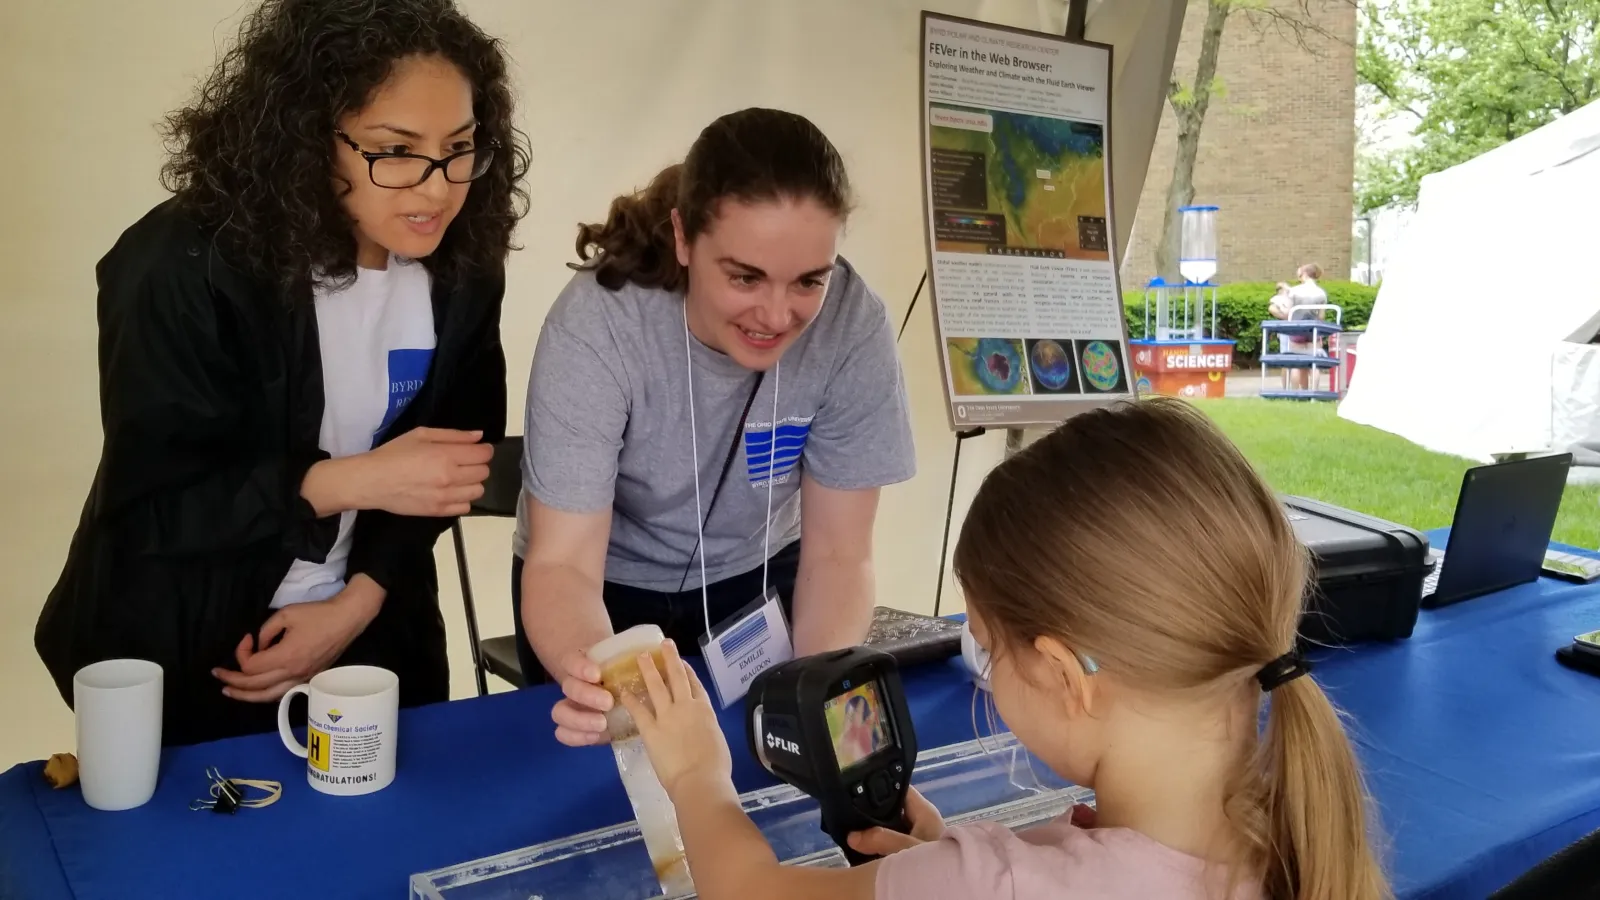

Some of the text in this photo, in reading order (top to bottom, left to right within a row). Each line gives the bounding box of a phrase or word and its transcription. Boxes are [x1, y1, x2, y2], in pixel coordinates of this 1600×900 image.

[929, 42, 1052, 72] FEVer in the Web Browser:
[928, 60, 957, 72] Exploring
[959, 64, 985, 75] Weather
[986, 69, 997, 77] and
[998, 71, 1020, 80] Climate
[1035, 76, 1045, 84] the
[1046, 78, 1060, 87] Fluid
[1061, 80, 1075, 89] Earth
[1076, 83, 1095, 92] Viewer
[1166, 354, 1229, 369] SCIENCE!
[391, 380, 423, 393] BYRD
[739, 647, 765, 670] EMILIE
[740, 657, 771, 684] BEAUDON
[323, 723, 352, 733] Chemical
[354, 724, 378, 733] Society
[311, 732, 320, 761] H
[774, 736, 801, 756] FLIR
